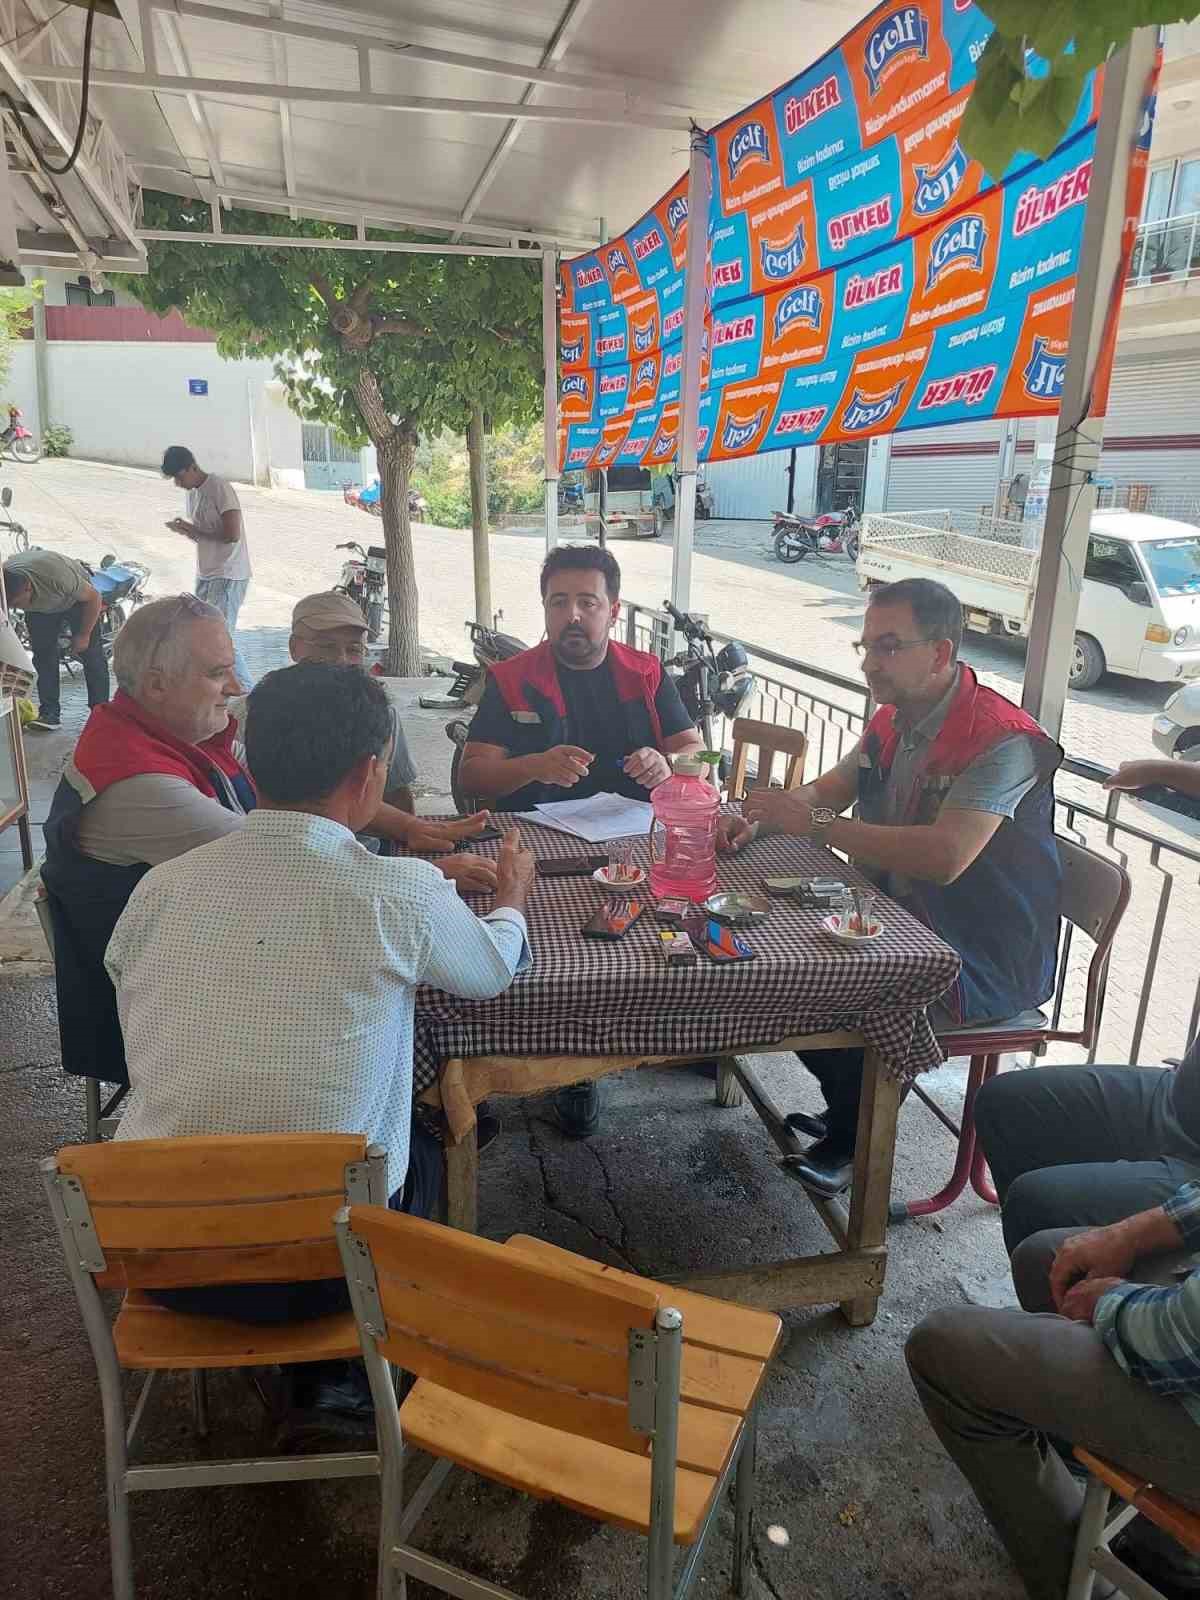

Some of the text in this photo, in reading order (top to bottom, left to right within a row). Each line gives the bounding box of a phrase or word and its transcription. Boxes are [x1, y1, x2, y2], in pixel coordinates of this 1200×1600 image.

[869, 9, 917, 70] Golf
[785, 76, 840, 134] ÜLKER
[730, 126, 762, 163] Golf
[1014, 160, 1092, 236] ÜLKER
[934, 219, 979, 268] Golf
[780, 290, 816, 321] Golf
[845, 266, 901, 307] ÜLKER
[562, 377, 586, 394] Golf
[919, 368, 995, 408] ÜLKER
[775, 408, 827, 434] ÜLKER
